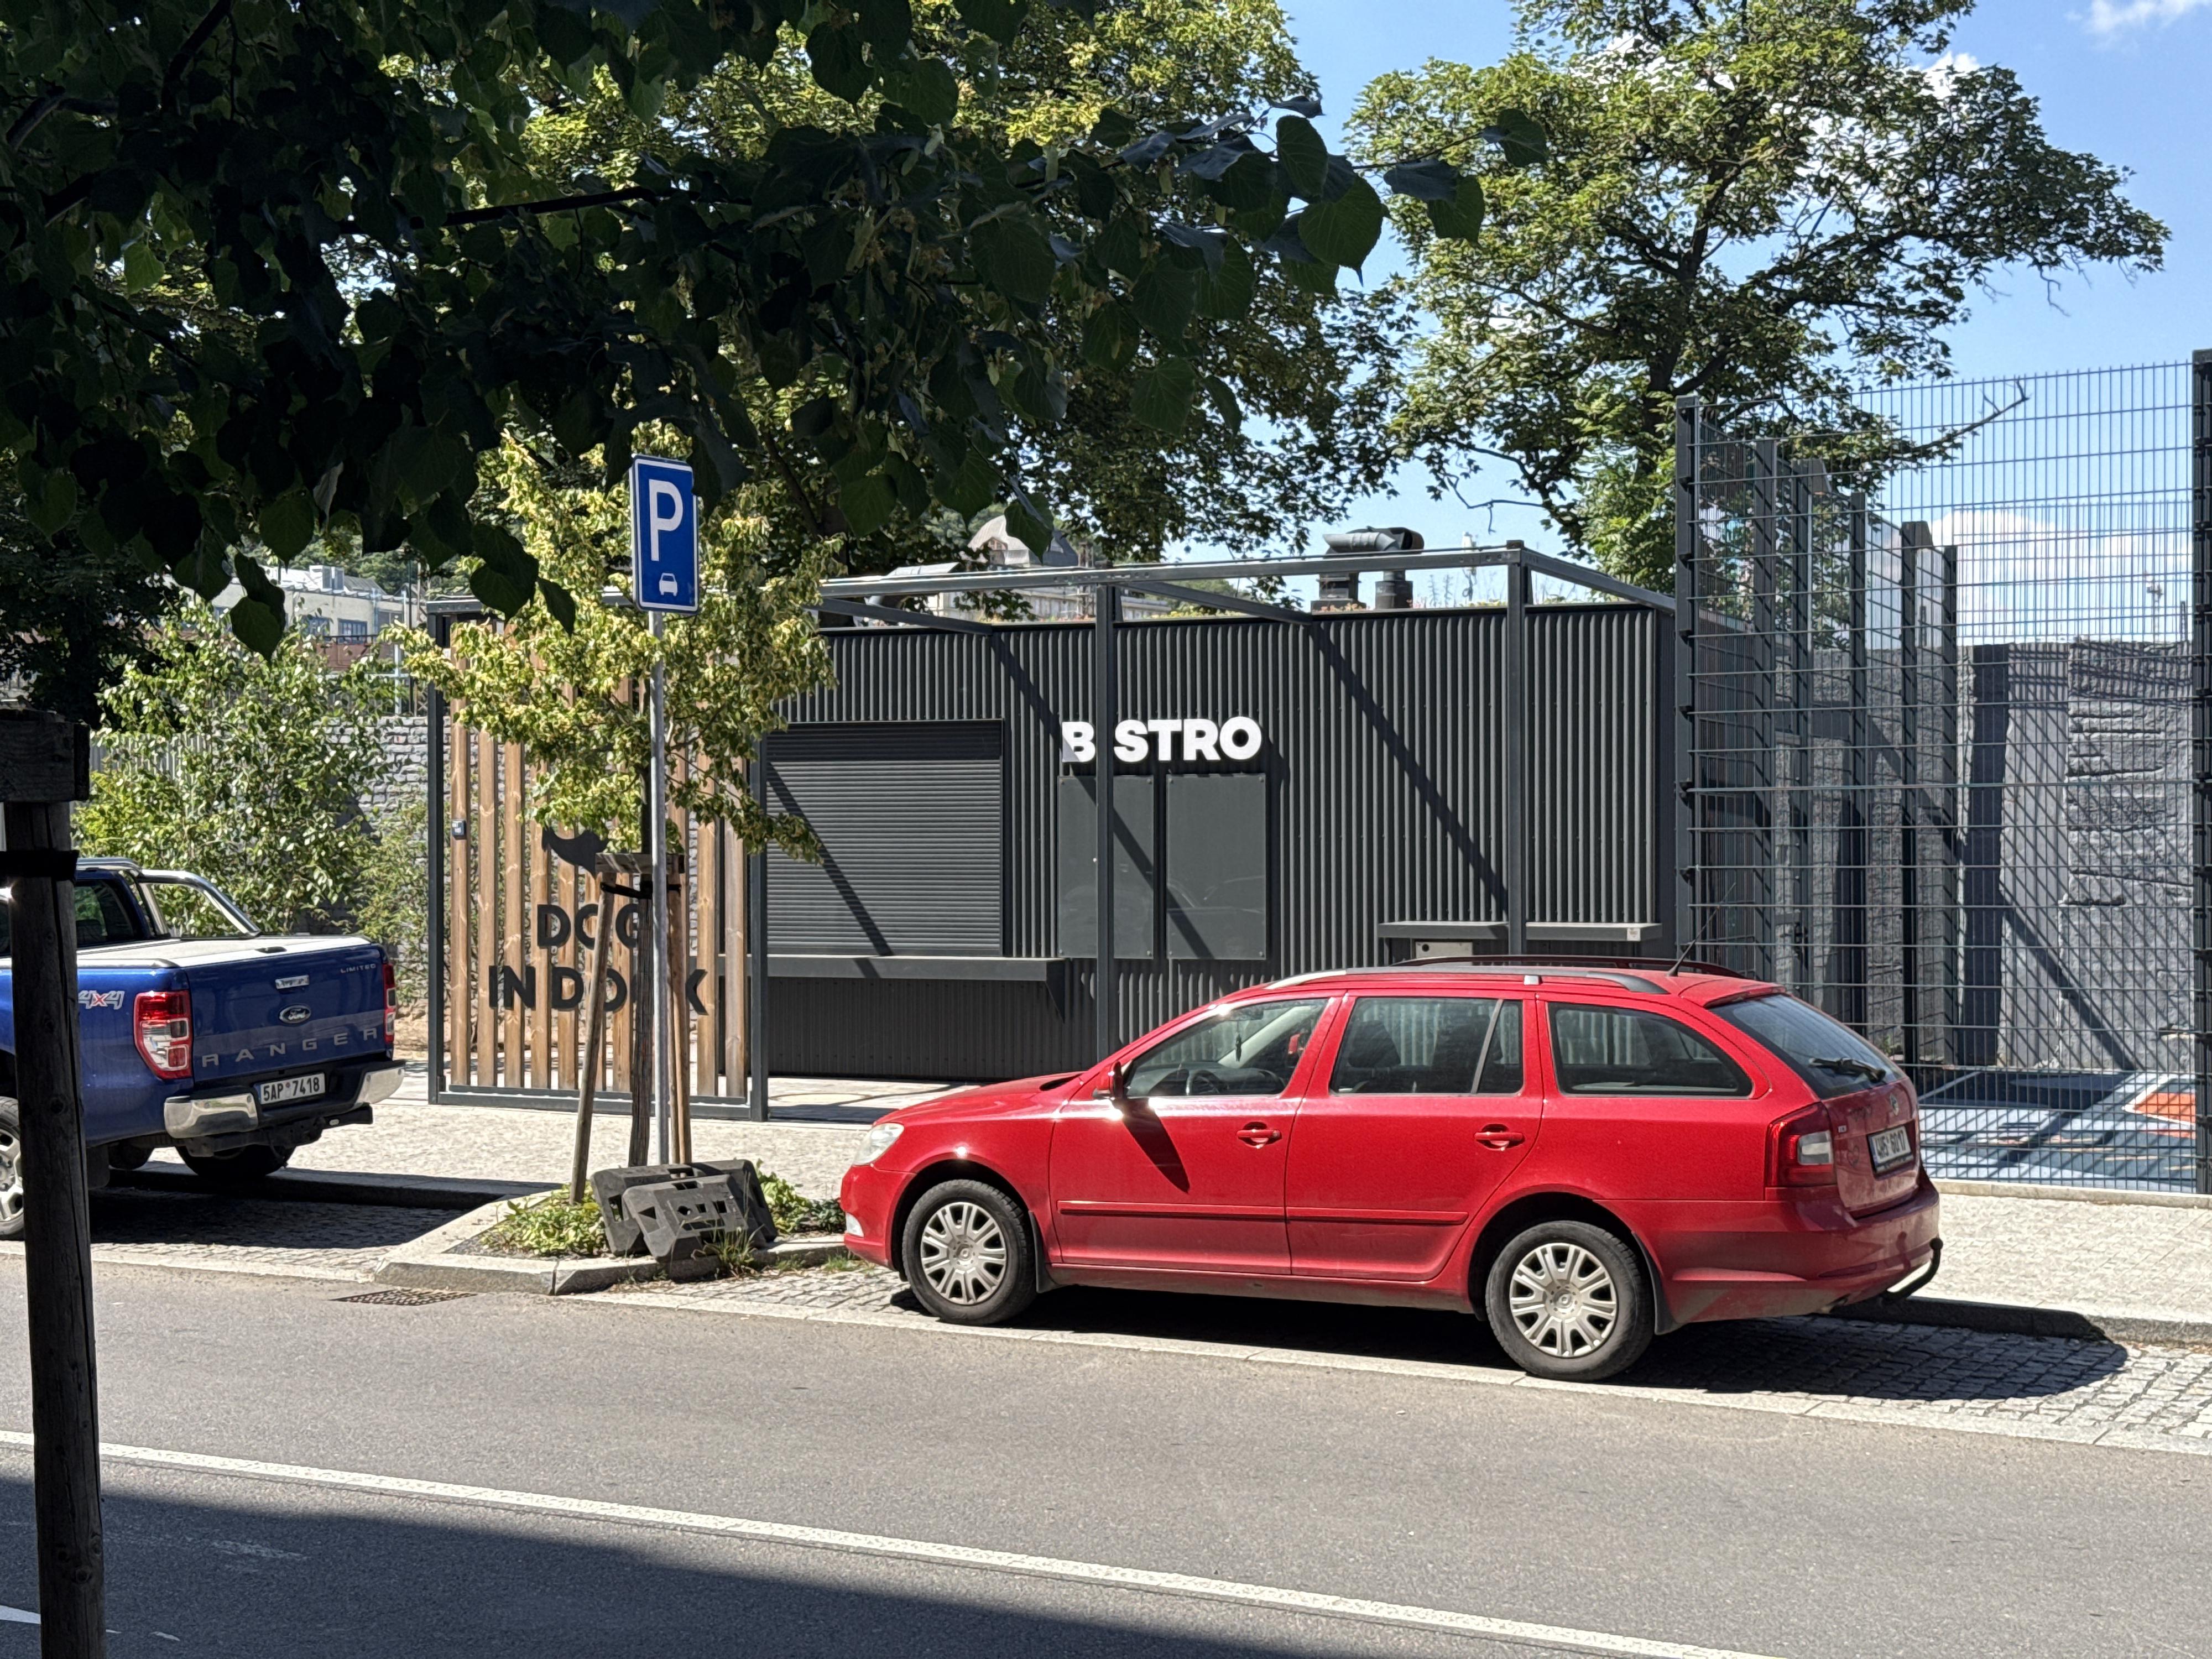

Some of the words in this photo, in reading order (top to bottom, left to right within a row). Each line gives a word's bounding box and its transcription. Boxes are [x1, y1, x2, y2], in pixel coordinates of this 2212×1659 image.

[648, 479, 683, 561] P
[1062, 716, 1261, 763] BSTRO
[340, 963, 376, 974] LIMITED
[202, 1027, 378, 1068] RANGER
[263, 1082, 284, 1102] 5AP
[292, 1077, 320, 1096] 7418
